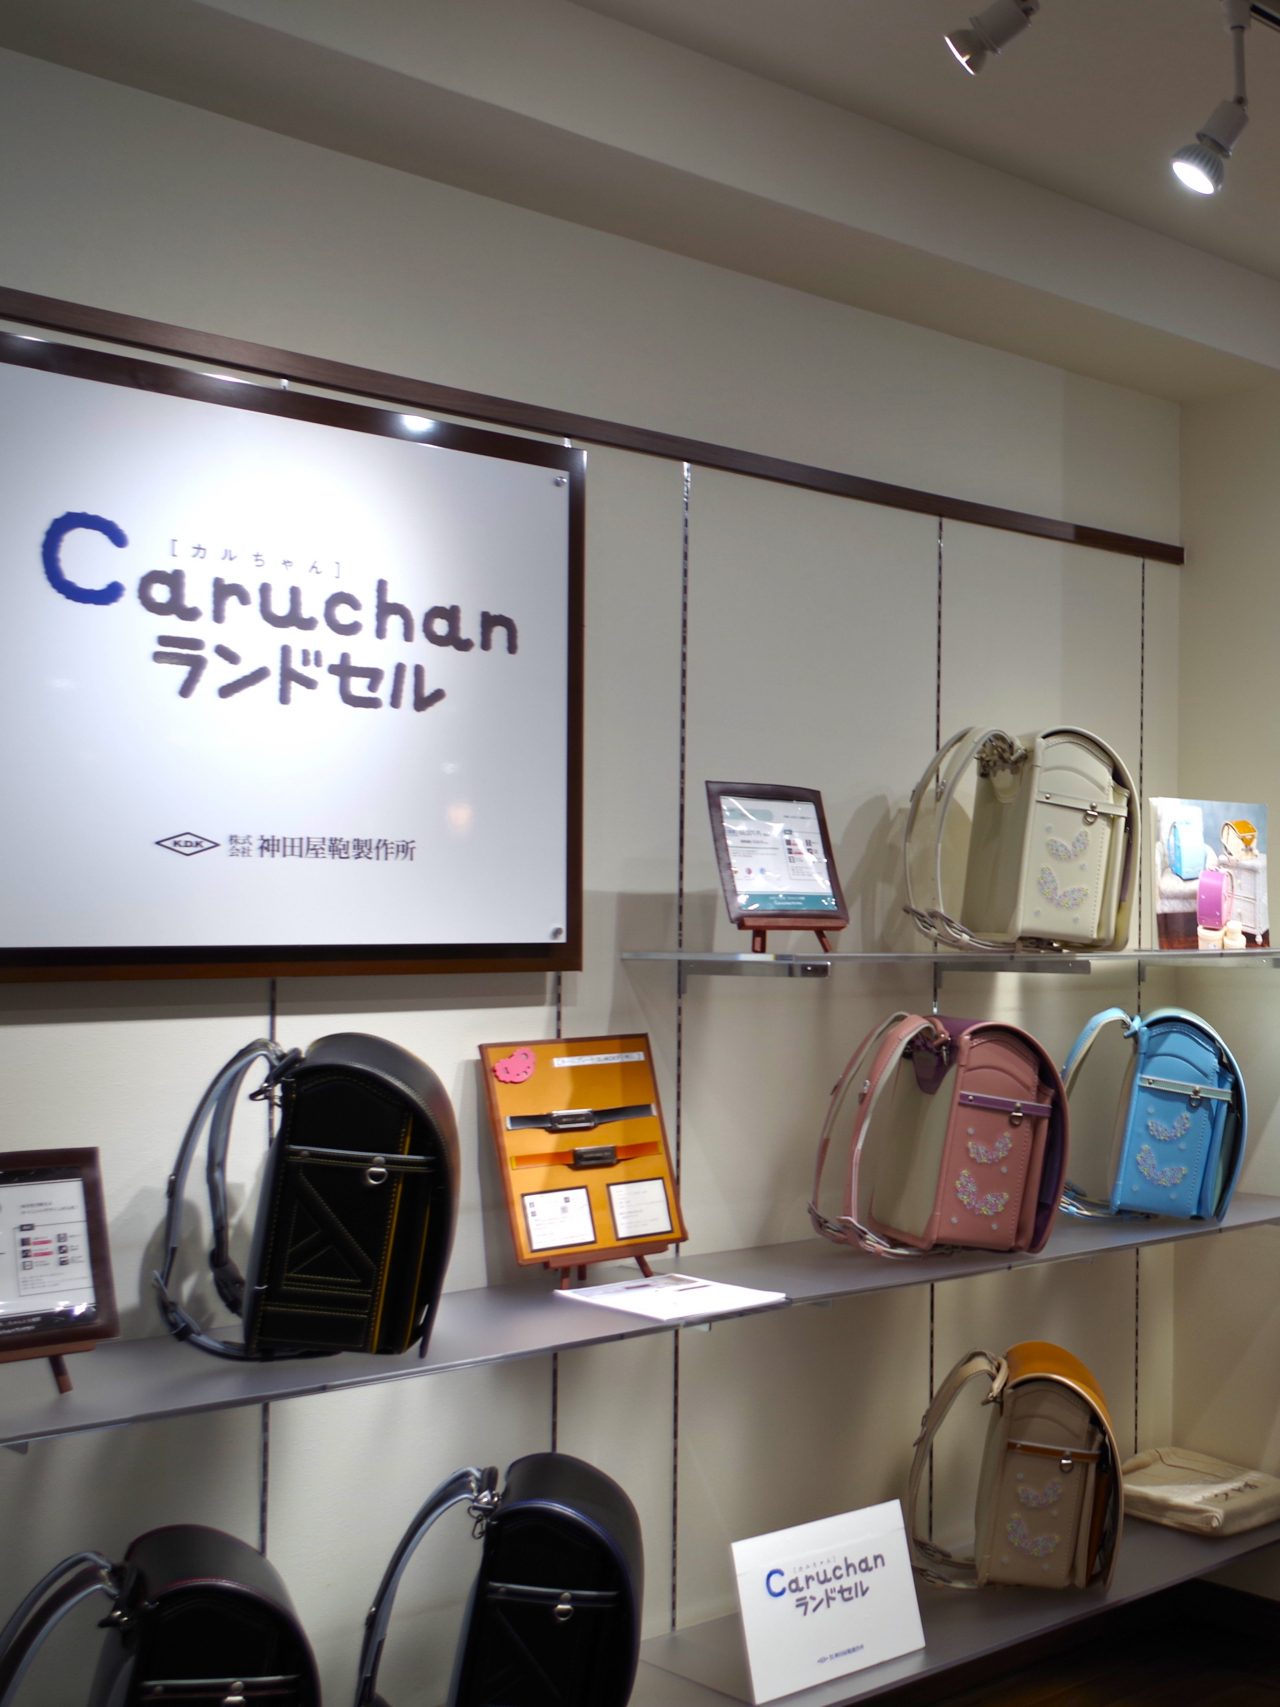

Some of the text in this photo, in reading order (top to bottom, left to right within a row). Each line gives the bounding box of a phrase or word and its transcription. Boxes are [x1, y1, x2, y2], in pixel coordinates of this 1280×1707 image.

[41, 511, 518, 655] Caruchan
[152, 635, 446, 712] ランドセル
[258, 834, 417, 862] 神田屋鞄製作所
[766, 1553, 886, 1598] Caruchan
[795, 1580, 870, 1616] ランドセル
